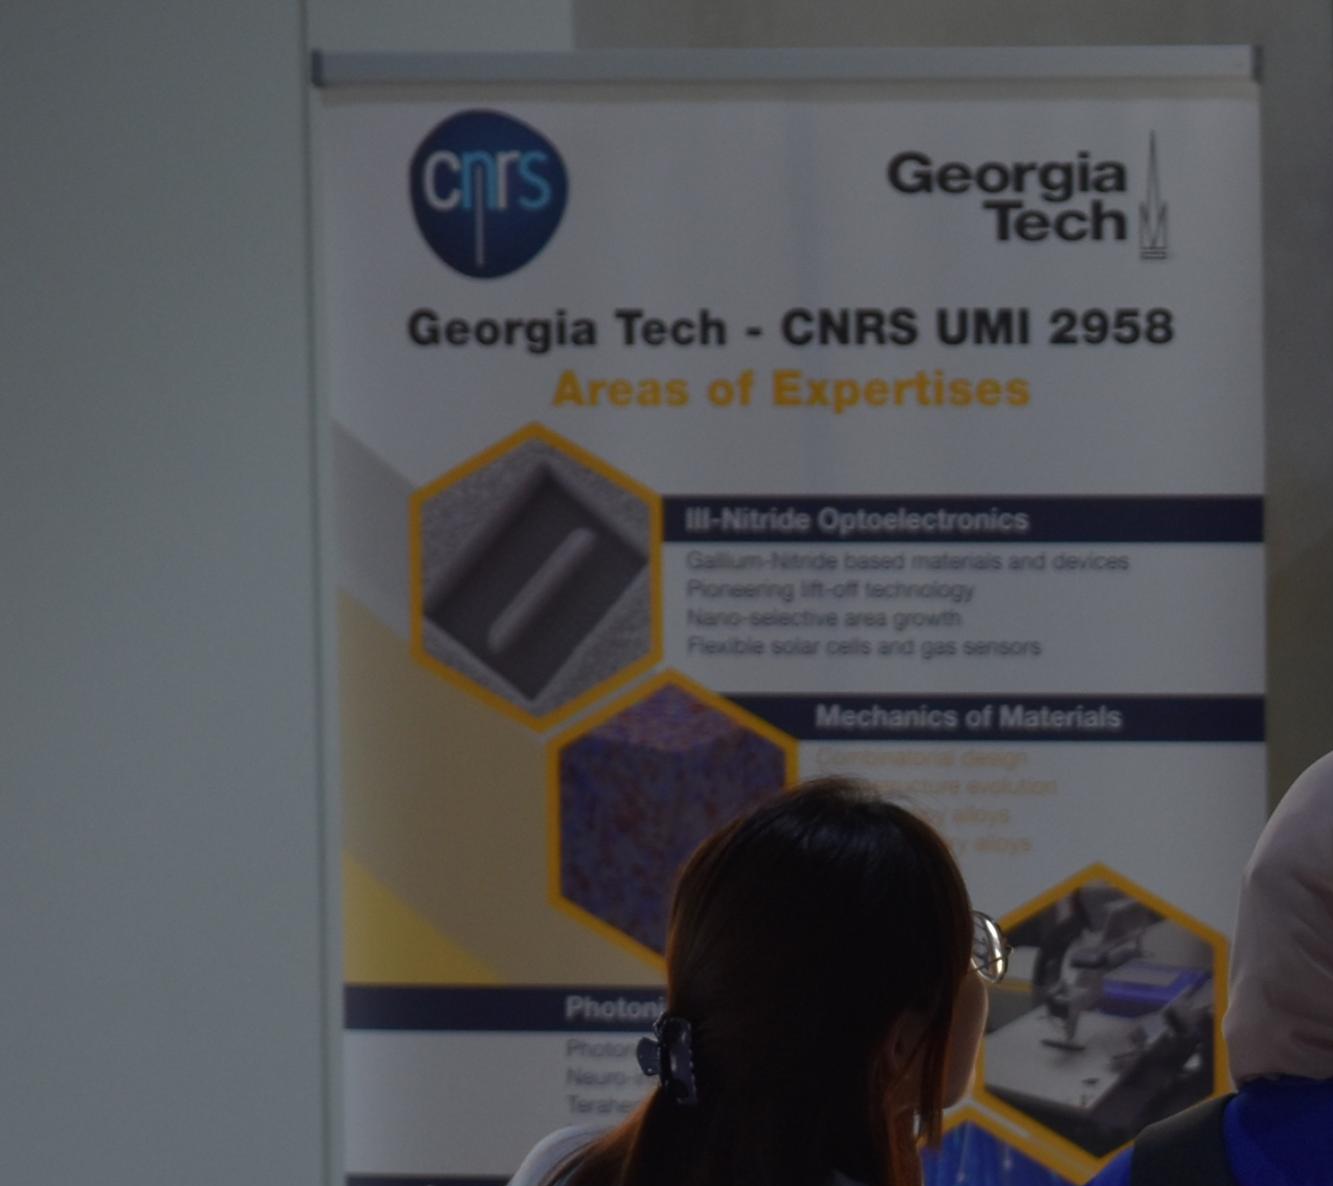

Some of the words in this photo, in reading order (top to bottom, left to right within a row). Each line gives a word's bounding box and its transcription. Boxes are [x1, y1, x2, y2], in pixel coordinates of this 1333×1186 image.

[886, 149, 1129, 203] Georgia
[981, 198, 1129, 243] Tech
[406, 307, 597, 355] Georgia
[613, 307, 727, 347] Tech
[780, 306, 919, 347] CNRS
[935, 307, 1030, 346] UMI
[1048, 307, 1175, 346] 2958
[552, 369, 689, 408] Areas
[706, 368, 754, 408] of
[772, 368, 1031, 413] Expertises
[684, 506, 811, 532] III-Nitride
[816, 506, 1030, 536] Optoelectronics
[842, 552, 906, 571] based
[910, 553, 1003, 572] materials
[1007, 551, 1046, 572] and
[1051, 553, 1130, 571] devices
[685, 578, 795, 604] Pioneering
[799, 579, 860, 600] lift-off
[863, 580, 975, 604] technology
[686, 607, 839, 628] Nano-selective
[843, 611, 888, 628] area
[892, 608, 962, 632] growth
[686, 634, 766, 657] Flexible
[770, 637, 820, 656] solar
[825, 637, 872, 657] cells
[876, 639, 915, 657] and
[919, 640, 958, 661] gas
[962, 640, 1043, 658] sensors
[815, 703, 959, 729] Mechanics
[964, 704, 993, 729] of
[998, 704, 1122, 729] Materials
